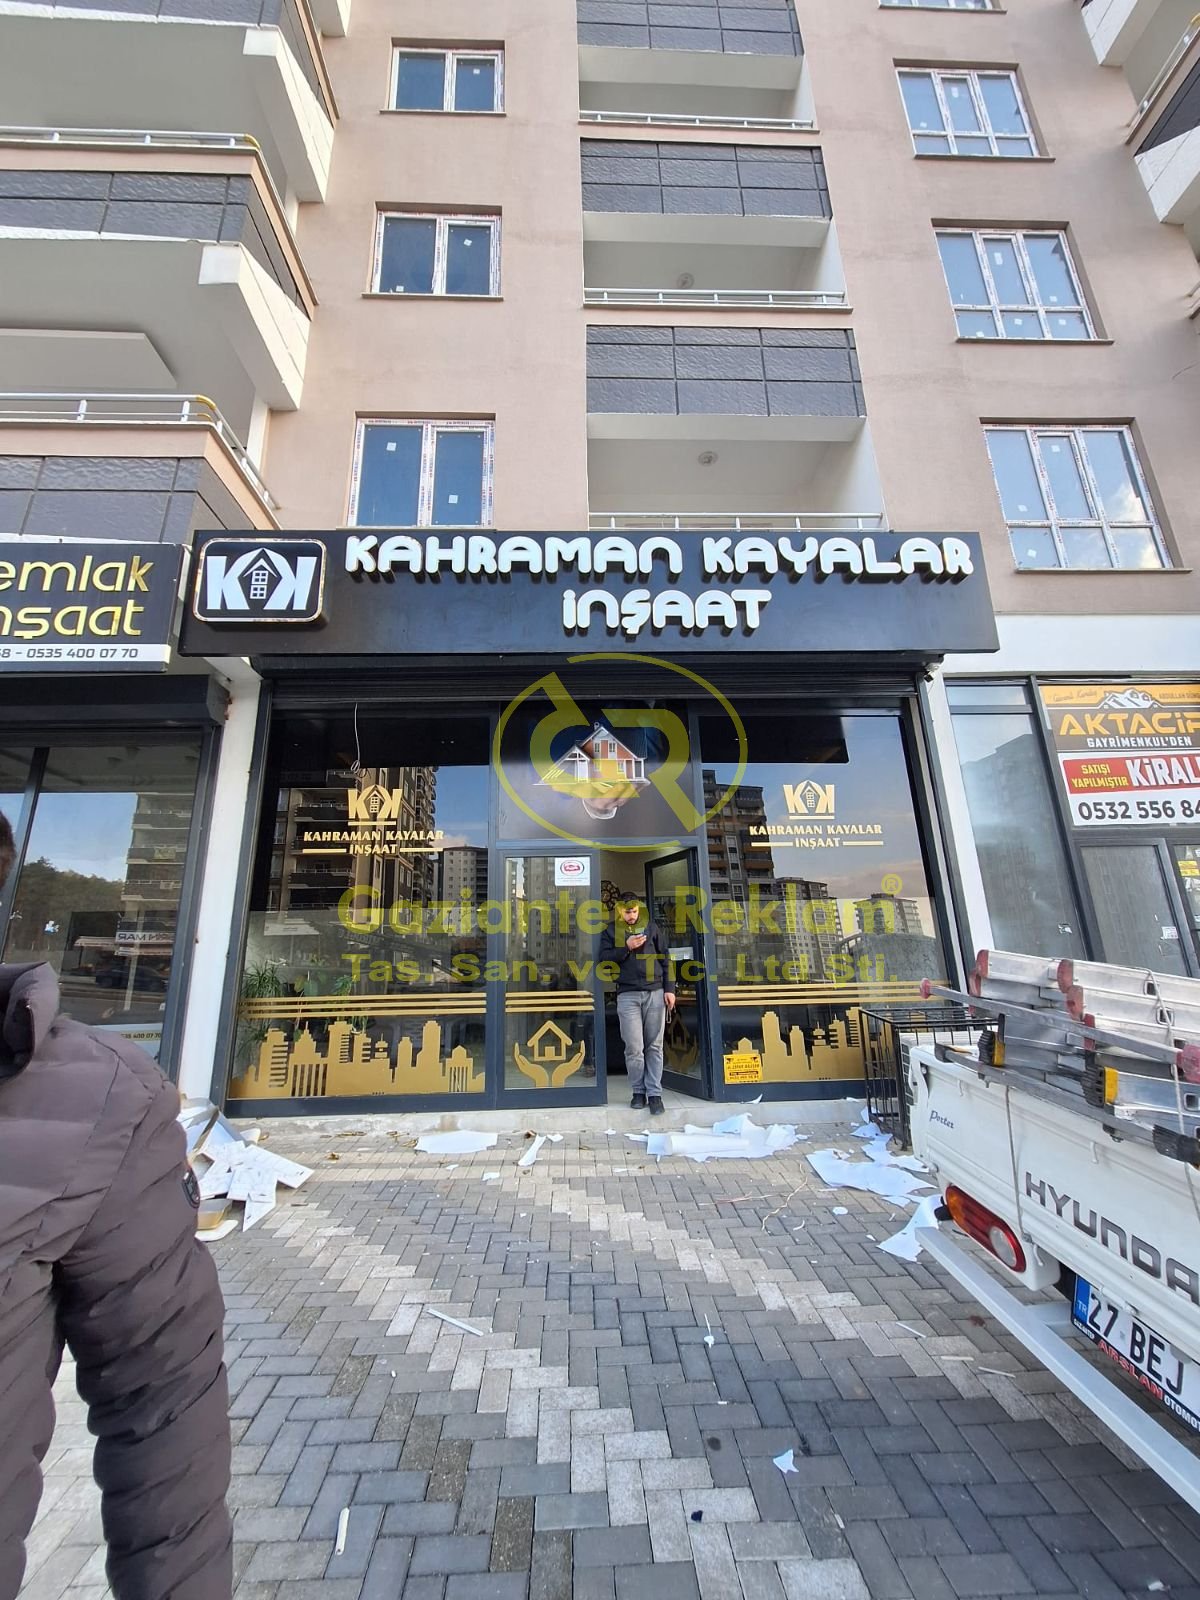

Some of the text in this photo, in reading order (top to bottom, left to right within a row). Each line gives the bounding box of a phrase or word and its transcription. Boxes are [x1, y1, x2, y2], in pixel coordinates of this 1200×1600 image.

[345, 536, 974, 575] KAHRAMAN KAYALAR
[26, 648, 62, 658] 0535
[66, 648, 95, 658] 400
[99, 648, 118, 658] 07
[121, 648, 138, 658] 70
[1078, 801, 1132, 820] 0532
[1136, 800, 1175, 819] 556
[303, 830, 444, 842] KAHRAMAN KAYALAR
[750, 824, 882, 836] KAHRAMAN KAYALAR
[929, 1110, 954, 1129] Porter
[1076, 1300, 1088, 1316] TR
[1089, 1292, 1184, 1396] 27 BEJ
[1097, 1338, 1165, 1400] ARSLAN
